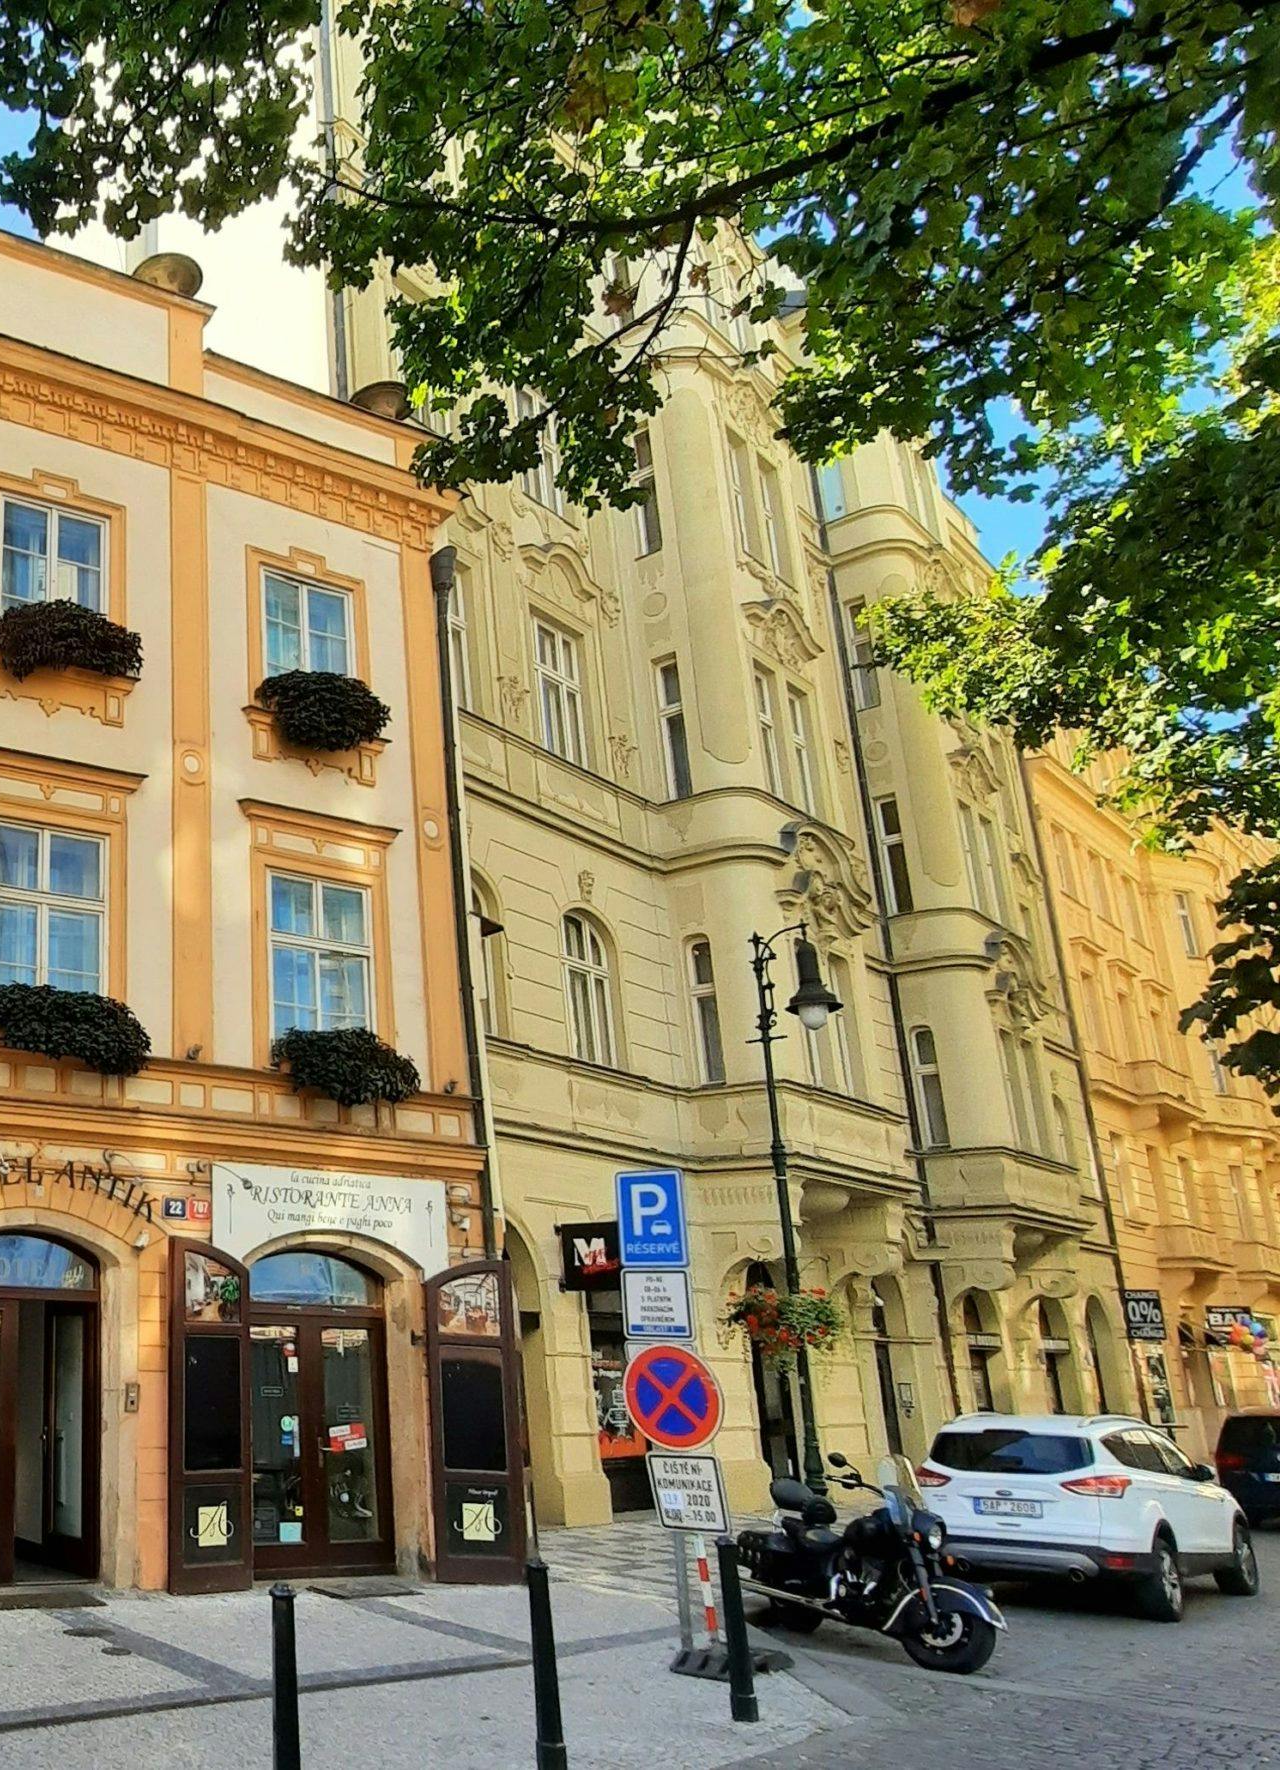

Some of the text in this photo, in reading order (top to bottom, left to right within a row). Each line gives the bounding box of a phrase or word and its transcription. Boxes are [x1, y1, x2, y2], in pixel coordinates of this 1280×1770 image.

[55, 1160, 159, 1224] ANTIK
[301, 1173, 330, 1186] cucina
[332, 1175, 372, 1189] adriatica
[169, 1200, 183, 1215] 22
[250, 1184, 415, 1215] RISTORANTE ANNA
[630, 1183, 668, 1236] P
[267, 1208, 285, 1224] Qui
[287, 1212, 316, 1226] mangi
[372, 1218, 393, 1230] poco
[1127, 1301, 1162, 1323] 0%
[657, 1478, 714, 1492] KOMUNIKACE
[686, 1493, 711, 1507] 2020
